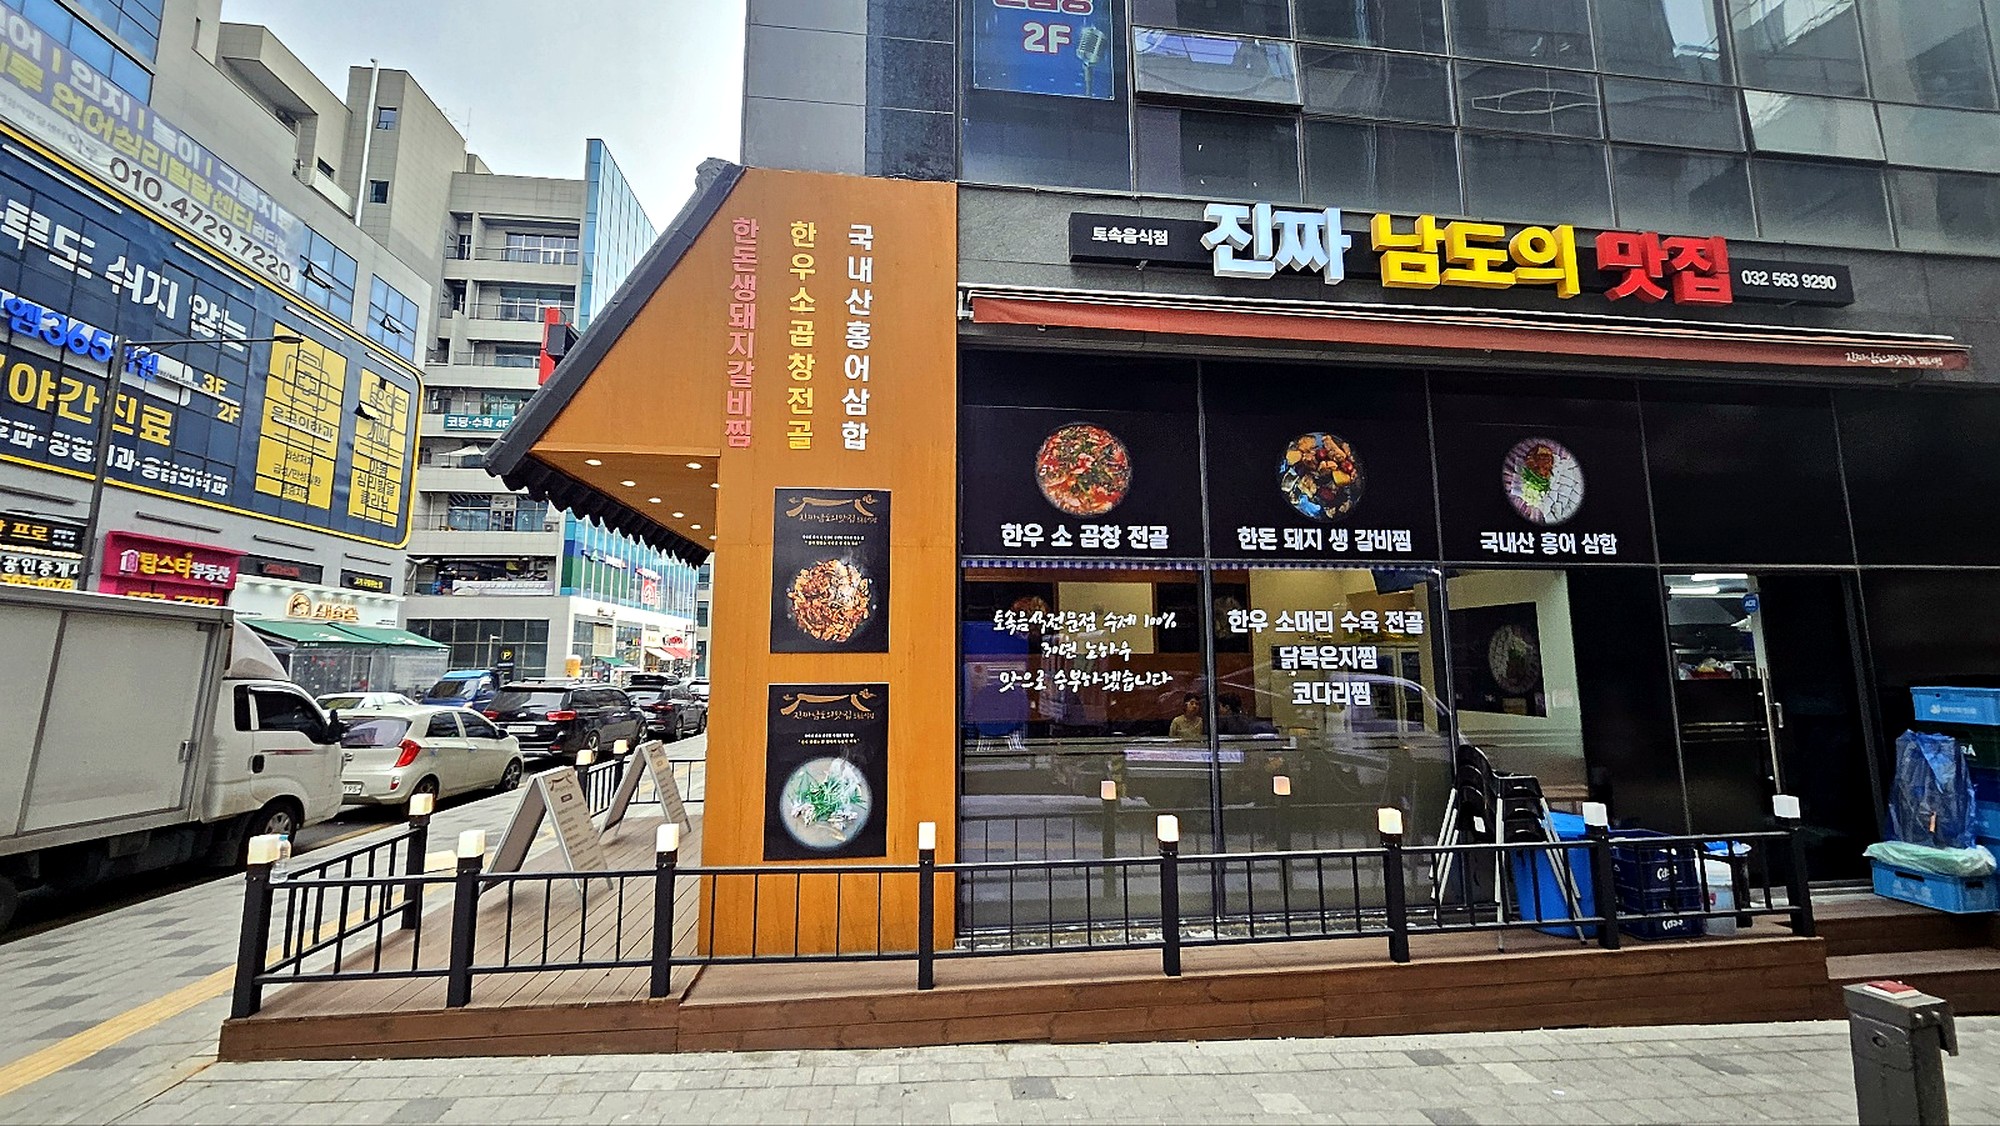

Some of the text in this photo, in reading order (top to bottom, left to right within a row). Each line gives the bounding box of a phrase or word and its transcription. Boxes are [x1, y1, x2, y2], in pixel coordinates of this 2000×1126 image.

[1023, 21, 1072, 54] 2F
[0, 8, 42, 62] 어
[69, 60, 131, 122] 인지
[110, 156, 291, 284] 010.4729.7220
[1091, 225, 1169, 246] 토속음식점
[1200, 203, 1735, 307] 진짜 남도의 맛집
[0, 198, 248, 352] 루도 쉬지 않는
[1741, 269, 1837, 290] 032 563 9290
[724, 216, 760, 449] 한돈생돼지갈비찜
[787, 220, 818, 450] 한우소곱창전골
[841, 223, 874, 451] 국내산홍어삼합
[203, 372, 228, 395] 3F
[217, 402, 241, 424] 2F
[12, 523, 49, 542] 프로
[1001, 522, 1169, 550] 한우 소 곱창 전골
[1237, 526, 1412, 553] 한돈 돼지 생 갈비찜
[1480, 531, 1535, 555] 국내산
[1581, 533, 1618, 556] 삼합
[1227, 609, 1424, 635] 한우 소머리 수육 전골
[1279, 645, 1378, 670] 닭묵은지찜
[999, 669, 1174, 694] 맛으로 승부하겠습니다
[1292, 681, 1371, 706] 코다리찜
